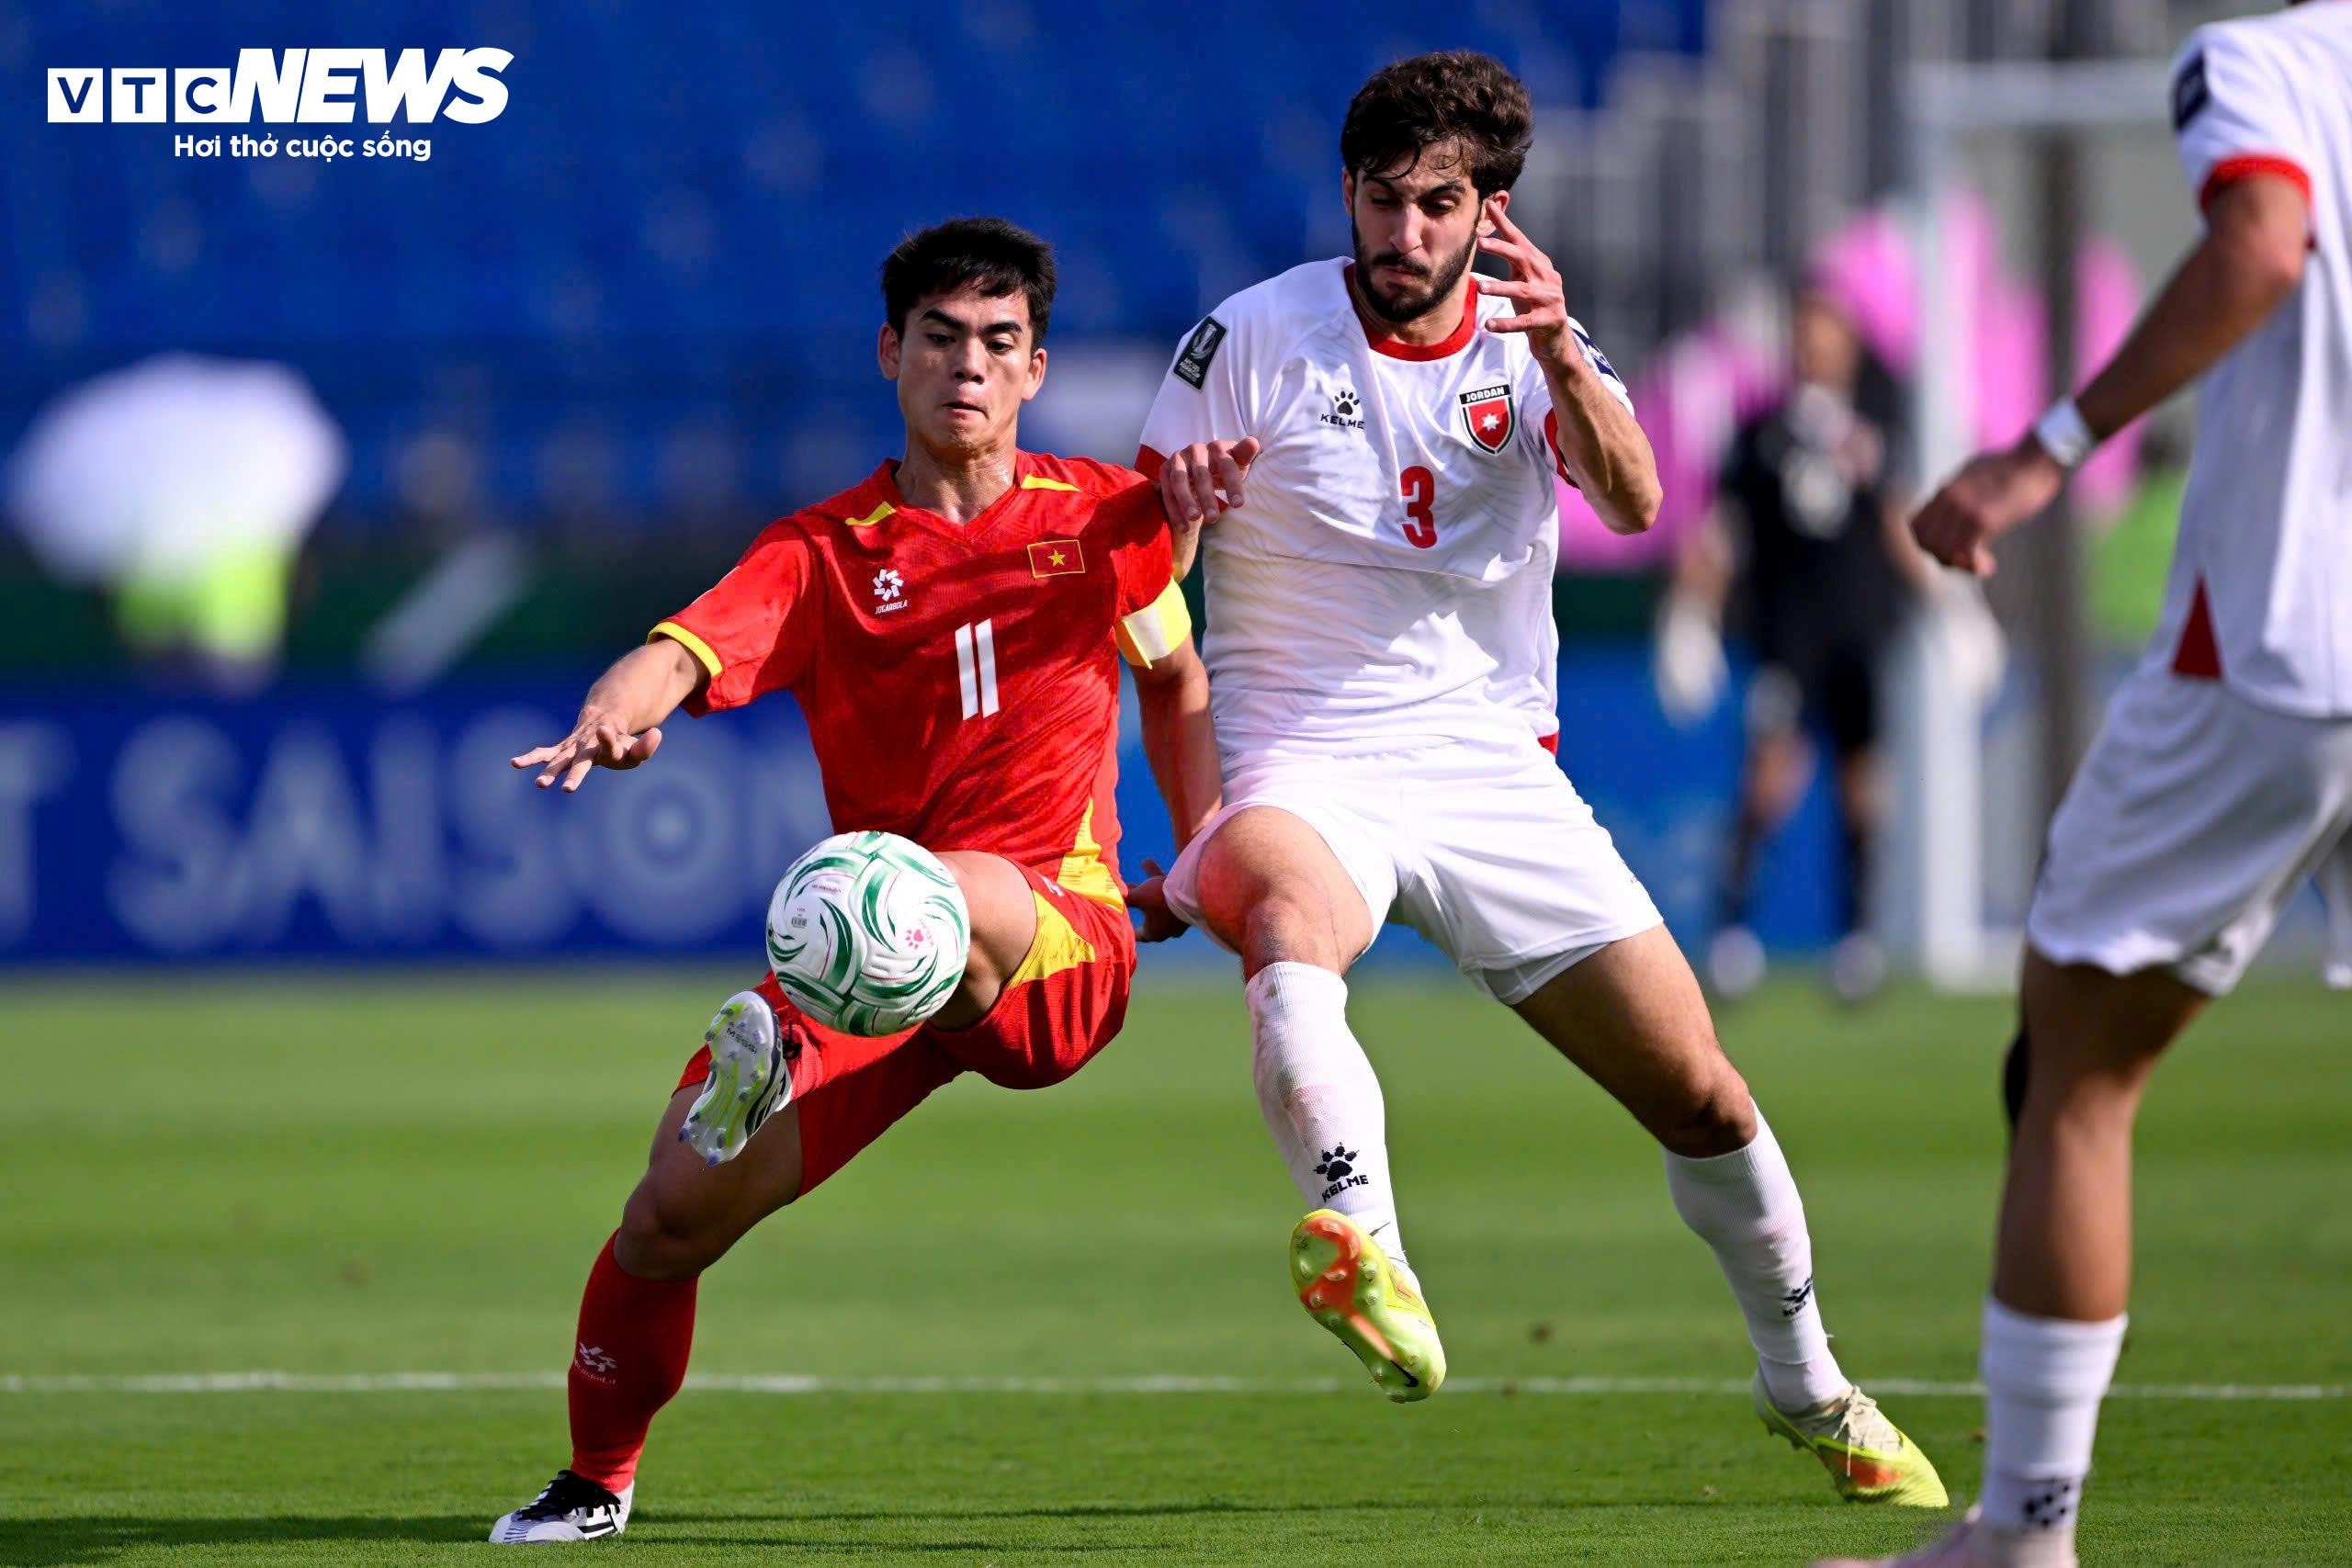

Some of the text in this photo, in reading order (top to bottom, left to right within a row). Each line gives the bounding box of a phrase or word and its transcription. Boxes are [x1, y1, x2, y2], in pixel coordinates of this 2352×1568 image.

[1465, 386, 1506, 403] JORDAN
[1320, 413, 1365, 430] KELME
[1399, 466, 1438, 549] 3
[955, 618, 1001, 721] 11
[1321, 1174, 1369, 1203] KELME
